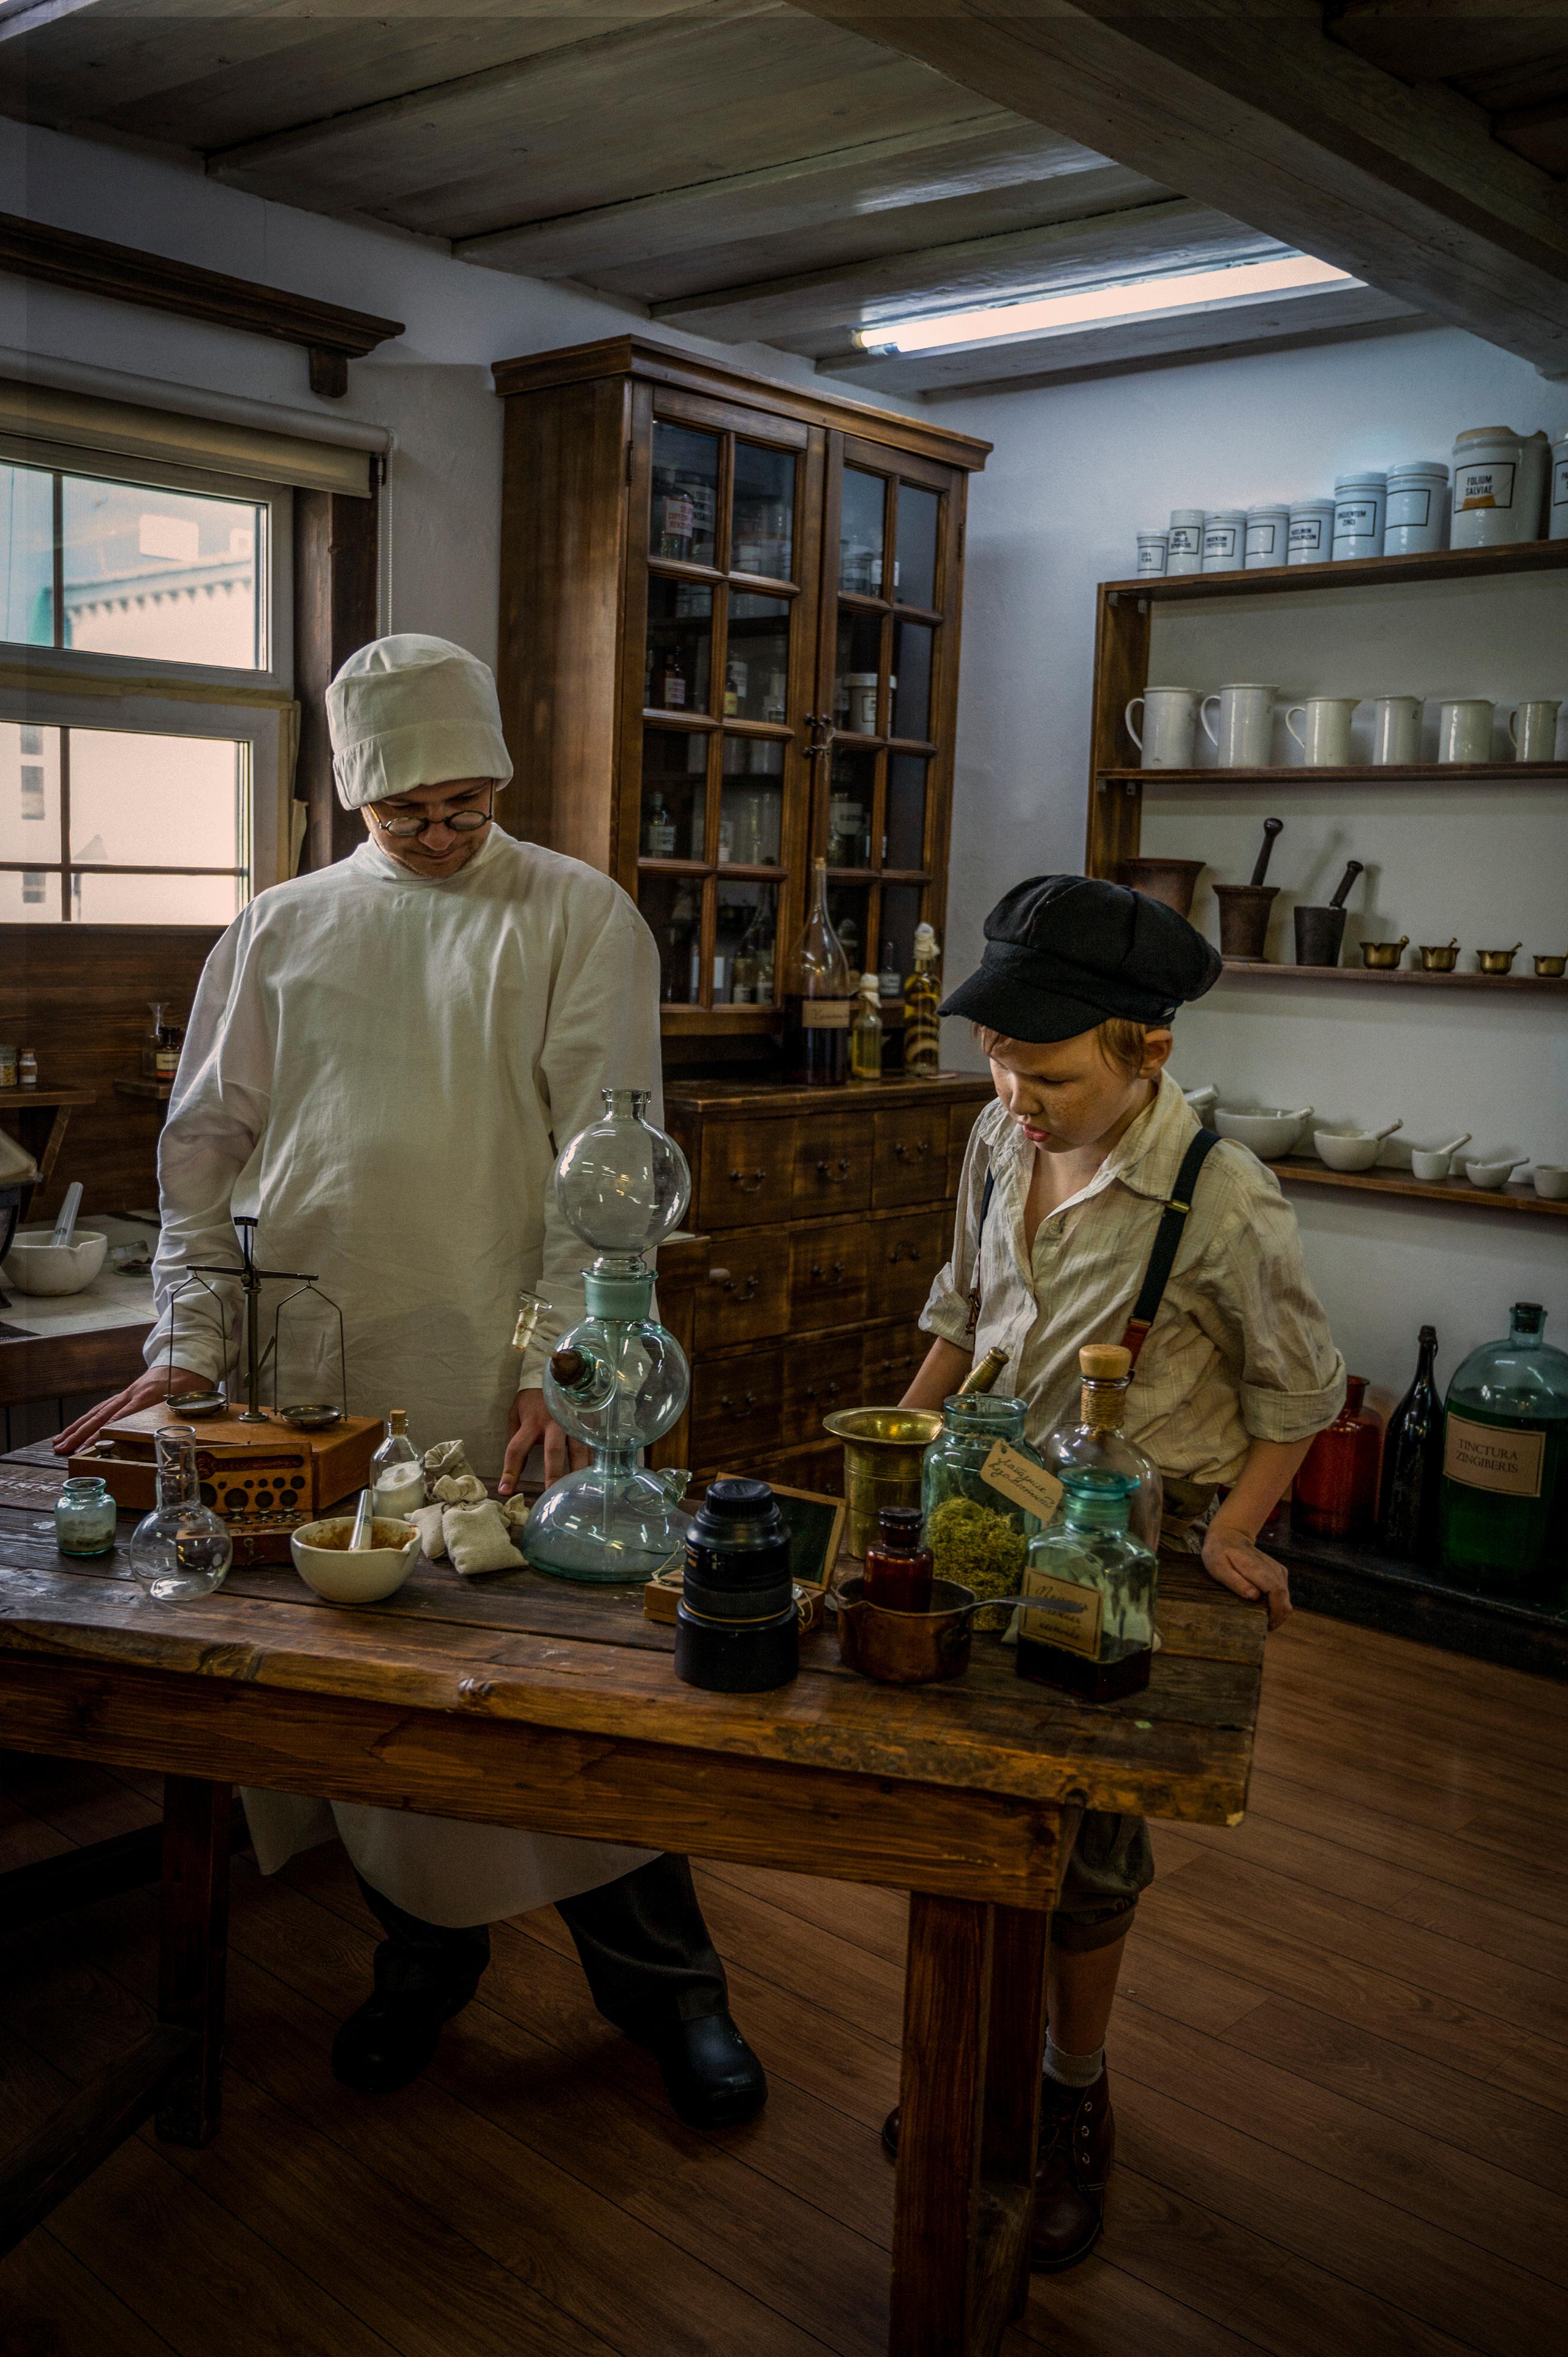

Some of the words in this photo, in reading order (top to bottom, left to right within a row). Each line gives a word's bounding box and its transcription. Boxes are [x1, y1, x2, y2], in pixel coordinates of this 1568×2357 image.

[1467, 475, 1493, 486] FOLIUM
[1466, 485, 1493, 496] SALVIAE
[1458, 1438, 1518, 1461] TINCTURA
[1456, 1450, 1518, 1473] ZINGIBERIS
